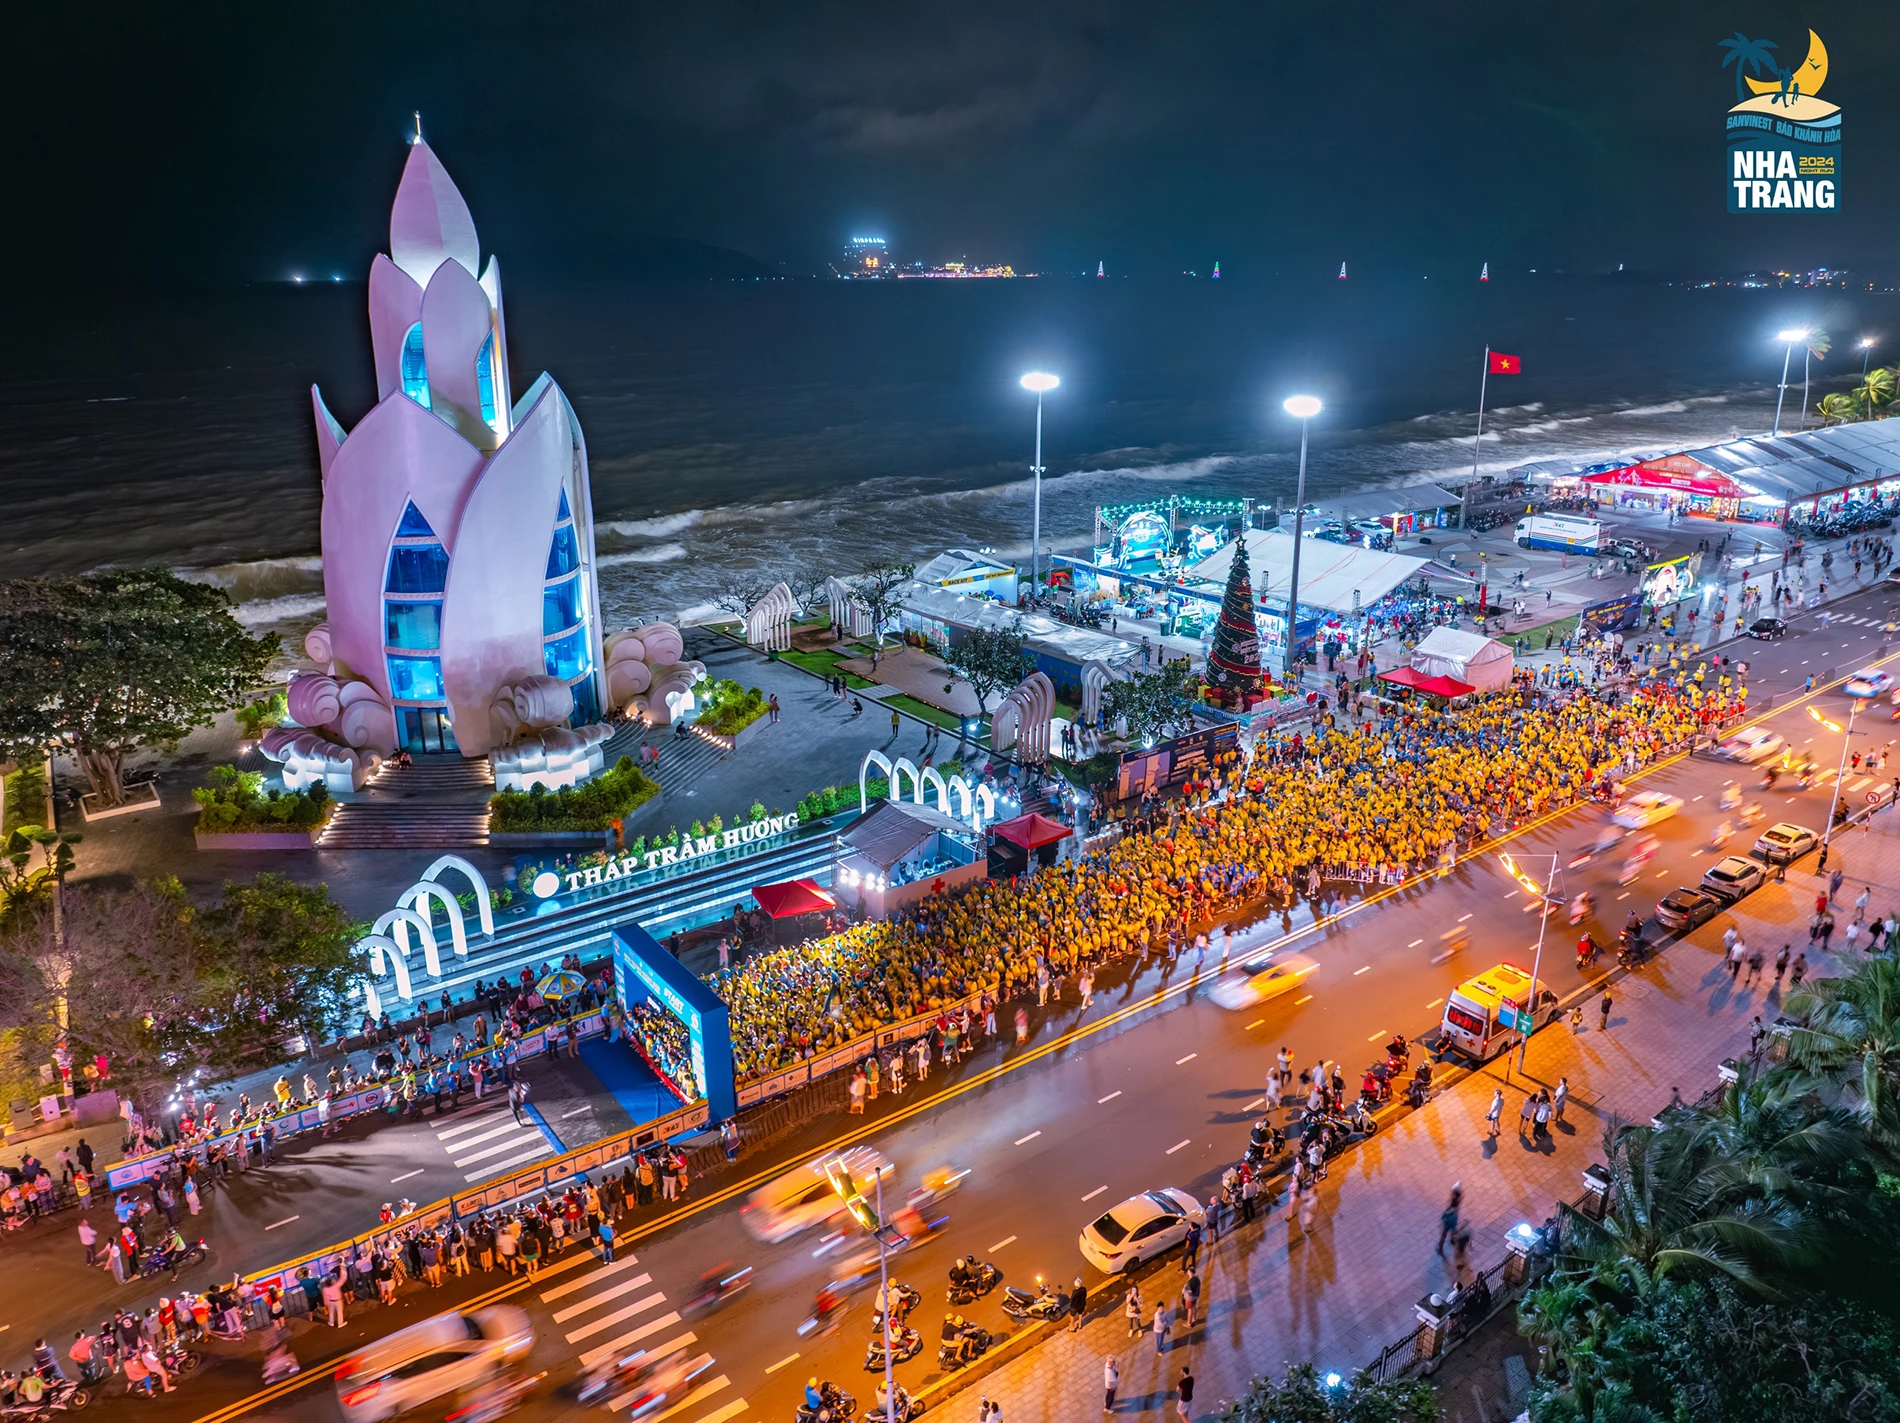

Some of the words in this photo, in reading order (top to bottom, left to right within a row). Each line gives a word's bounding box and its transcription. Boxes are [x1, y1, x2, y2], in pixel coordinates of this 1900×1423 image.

[564, 855, 638, 891] THÁP
[644, 832, 717, 870] TRẦM
[722, 812, 800, 849] HƯƠNG
